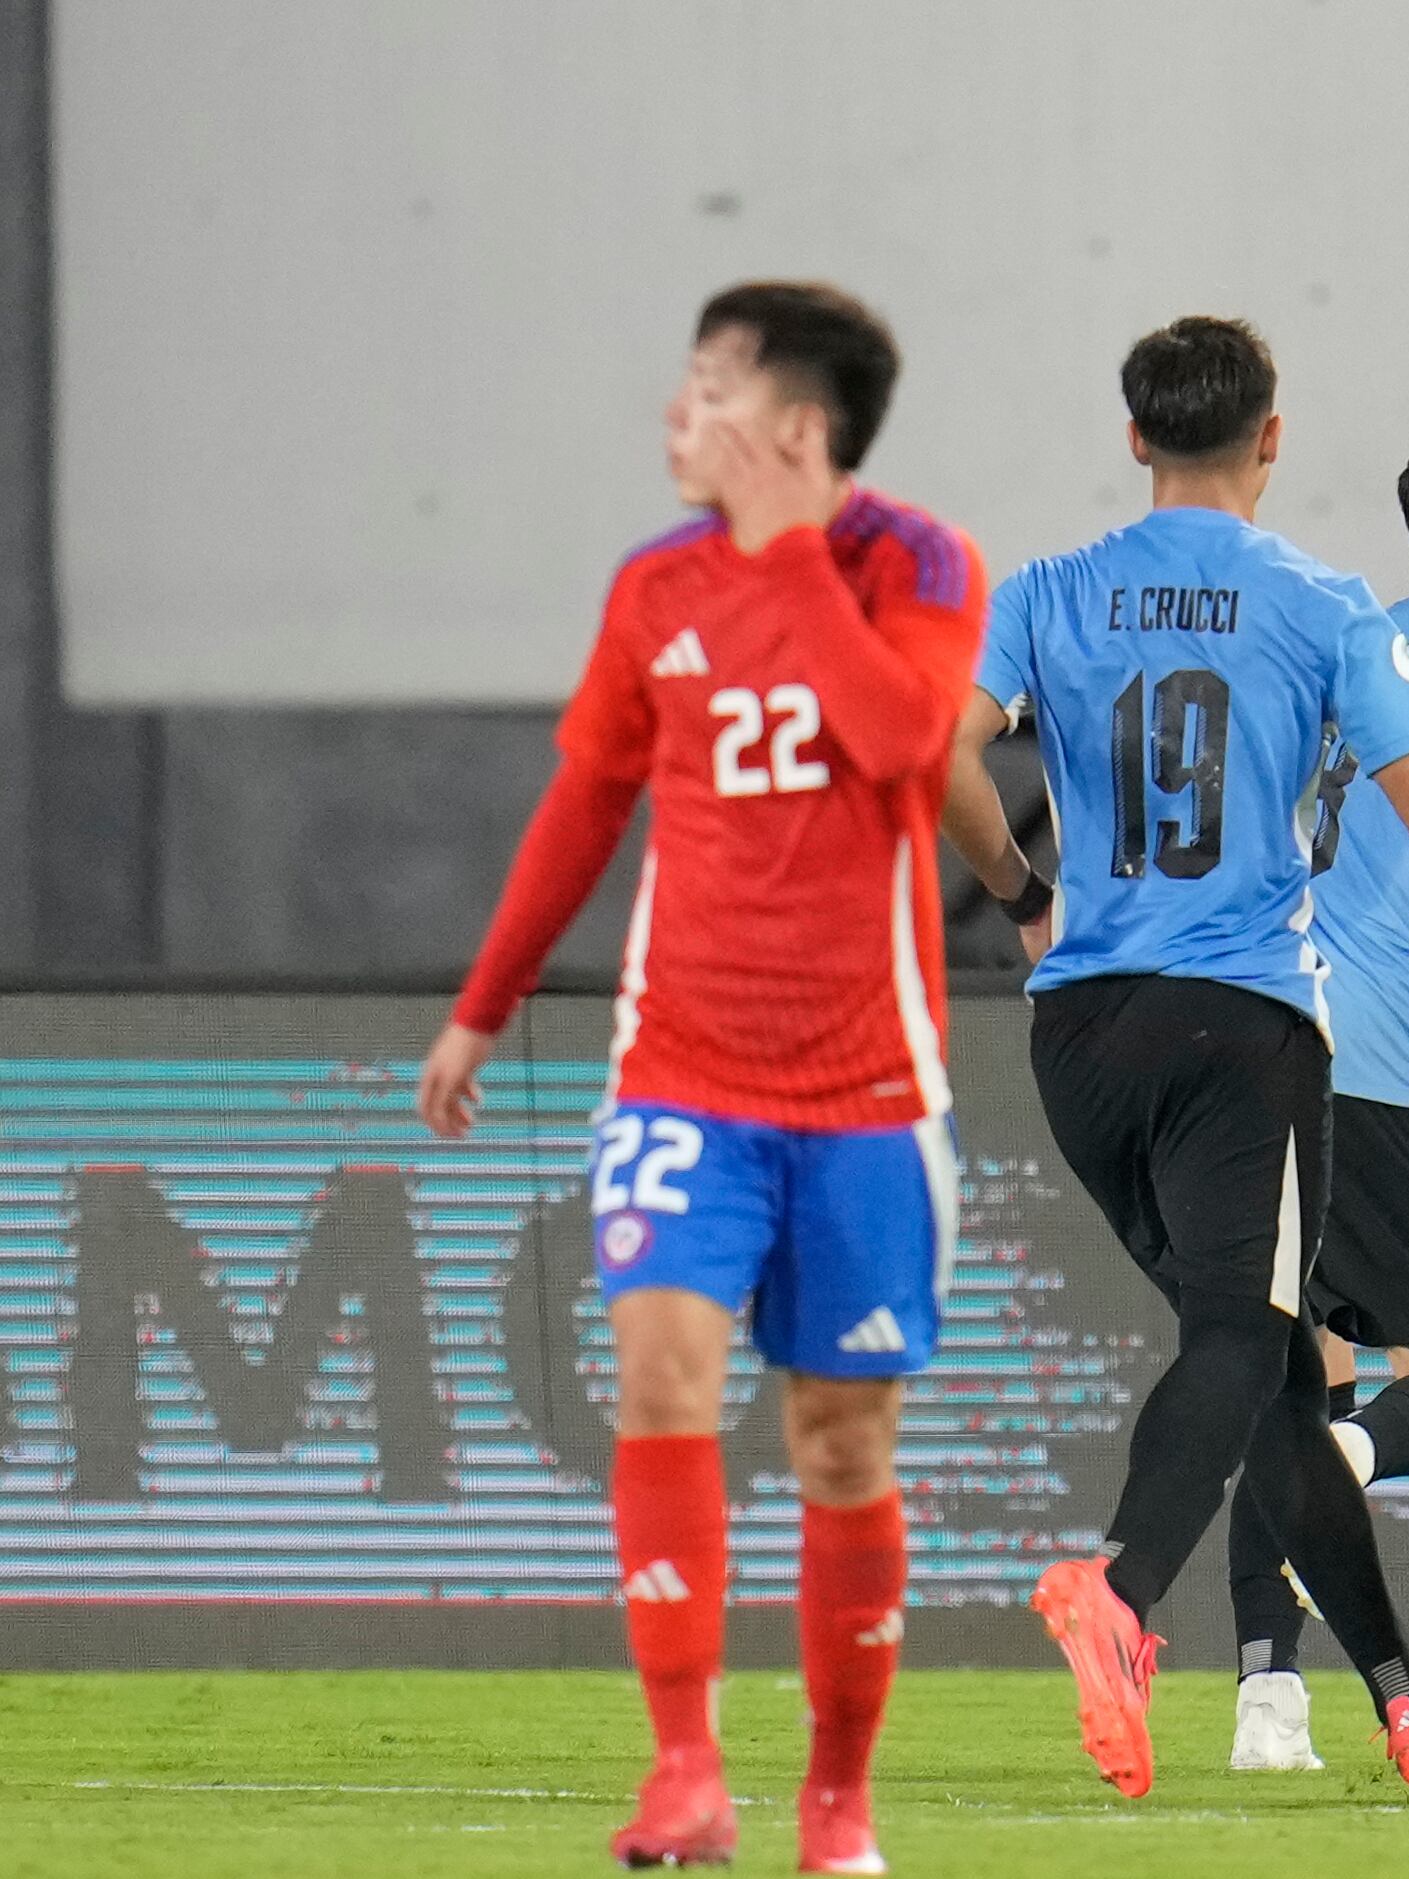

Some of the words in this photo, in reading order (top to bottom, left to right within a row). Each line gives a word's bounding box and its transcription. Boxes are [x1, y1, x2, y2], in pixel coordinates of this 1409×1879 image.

[1109, 588, 1131, 632] E.
[1140, 586, 1239, 634] CRUCCI
[709, 683, 831, 798] 22
[1110, 668, 1229, 880] 19
[592, 1114, 704, 1215] 22
